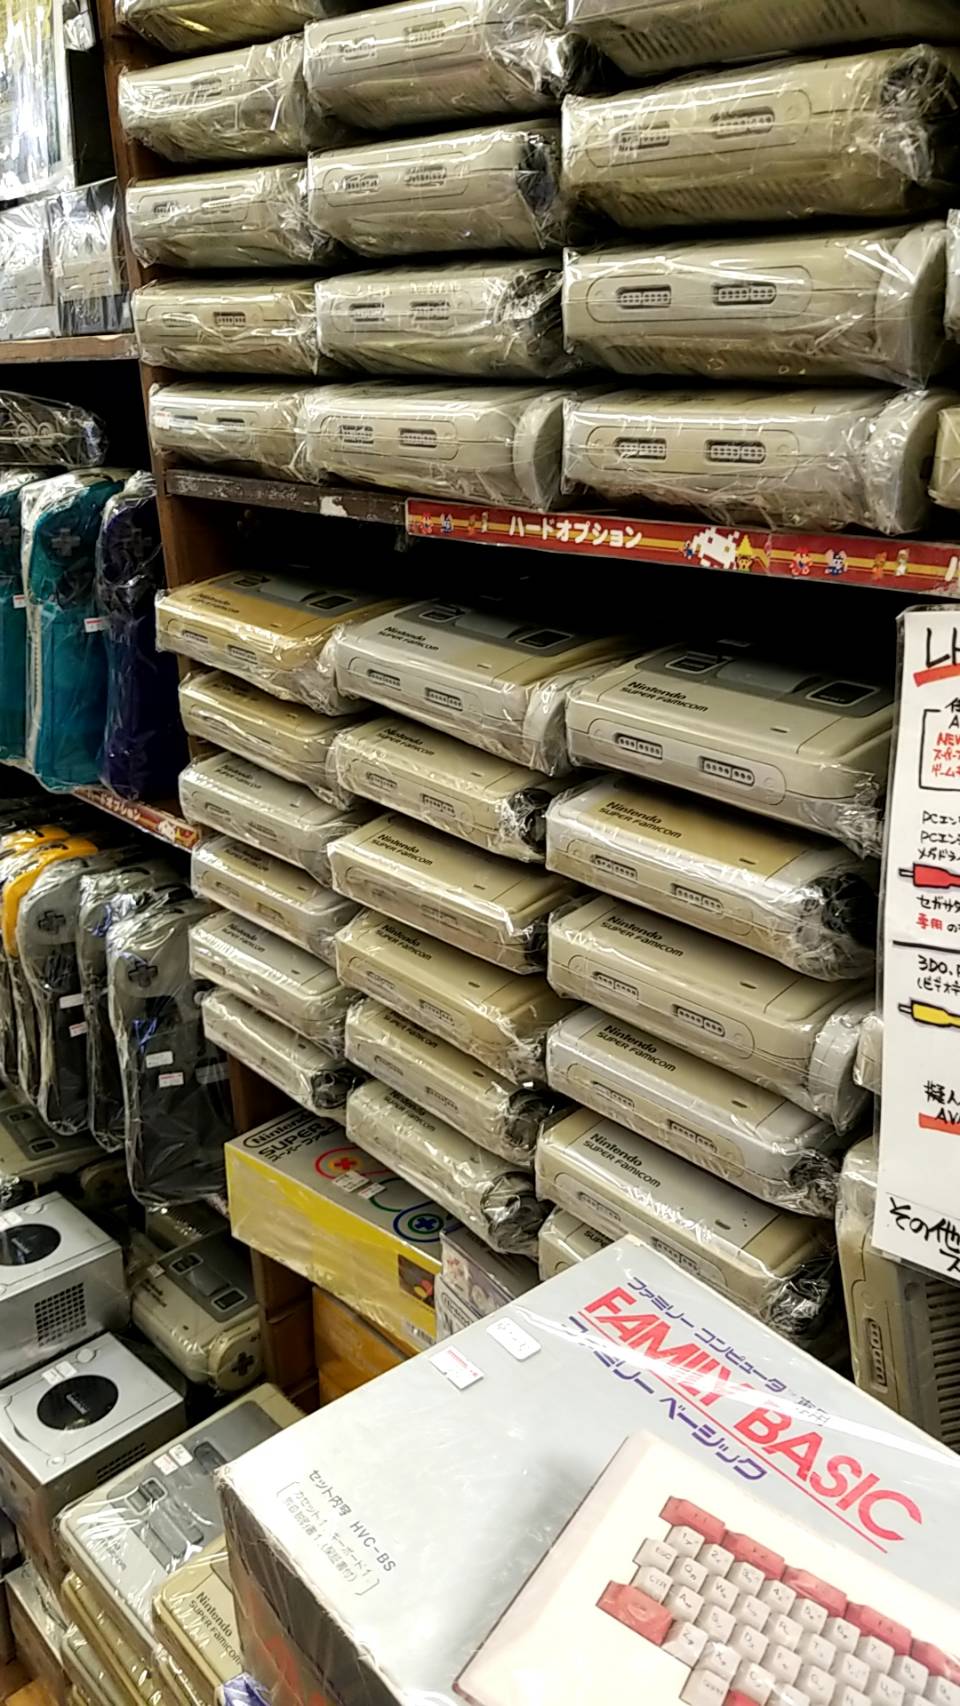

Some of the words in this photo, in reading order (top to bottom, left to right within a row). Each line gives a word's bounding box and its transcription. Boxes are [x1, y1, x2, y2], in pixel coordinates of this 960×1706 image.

[508, 515, 643, 549] ハードオプション
[620, 687, 657, 699] SUPER
[628, 681, 687, 699] Nintendo
[599, 807, 633, 821] SUPER
[606, 801, 662, 824] Nintendo
[922, 810, 960, 825] PCエン
[378, 834, 420, 853] Nintendo
[920, 830, 960, 845] PCエン
[600, 921, 635, 938] SUPER
[607, 916, 662, 940] Nintendo
[596, 1031, 630, 1050] SUPER
[603, 1024, 657, 1054] Nintendo
[935, 1107, 960, 1125] AV
[258, 1122, 326, 1158] SUPER
[583, 1140, 616, 1161] SUPER
[590, 1132, 643, 1167] Nintendo
[626, 1277, 694, 1328] ファミリー
[694, 1327, 787, 1392] コンピュータ
[584, 1286, 757, 1407] FAMILY
[733, 1402, 922, 1541] BASIC
[659, 1397, 768, 1481] ベーシック
[349, 1519, 397, 1571] HVC-BS
[196, 1591, 233, 1637] Nintendo
